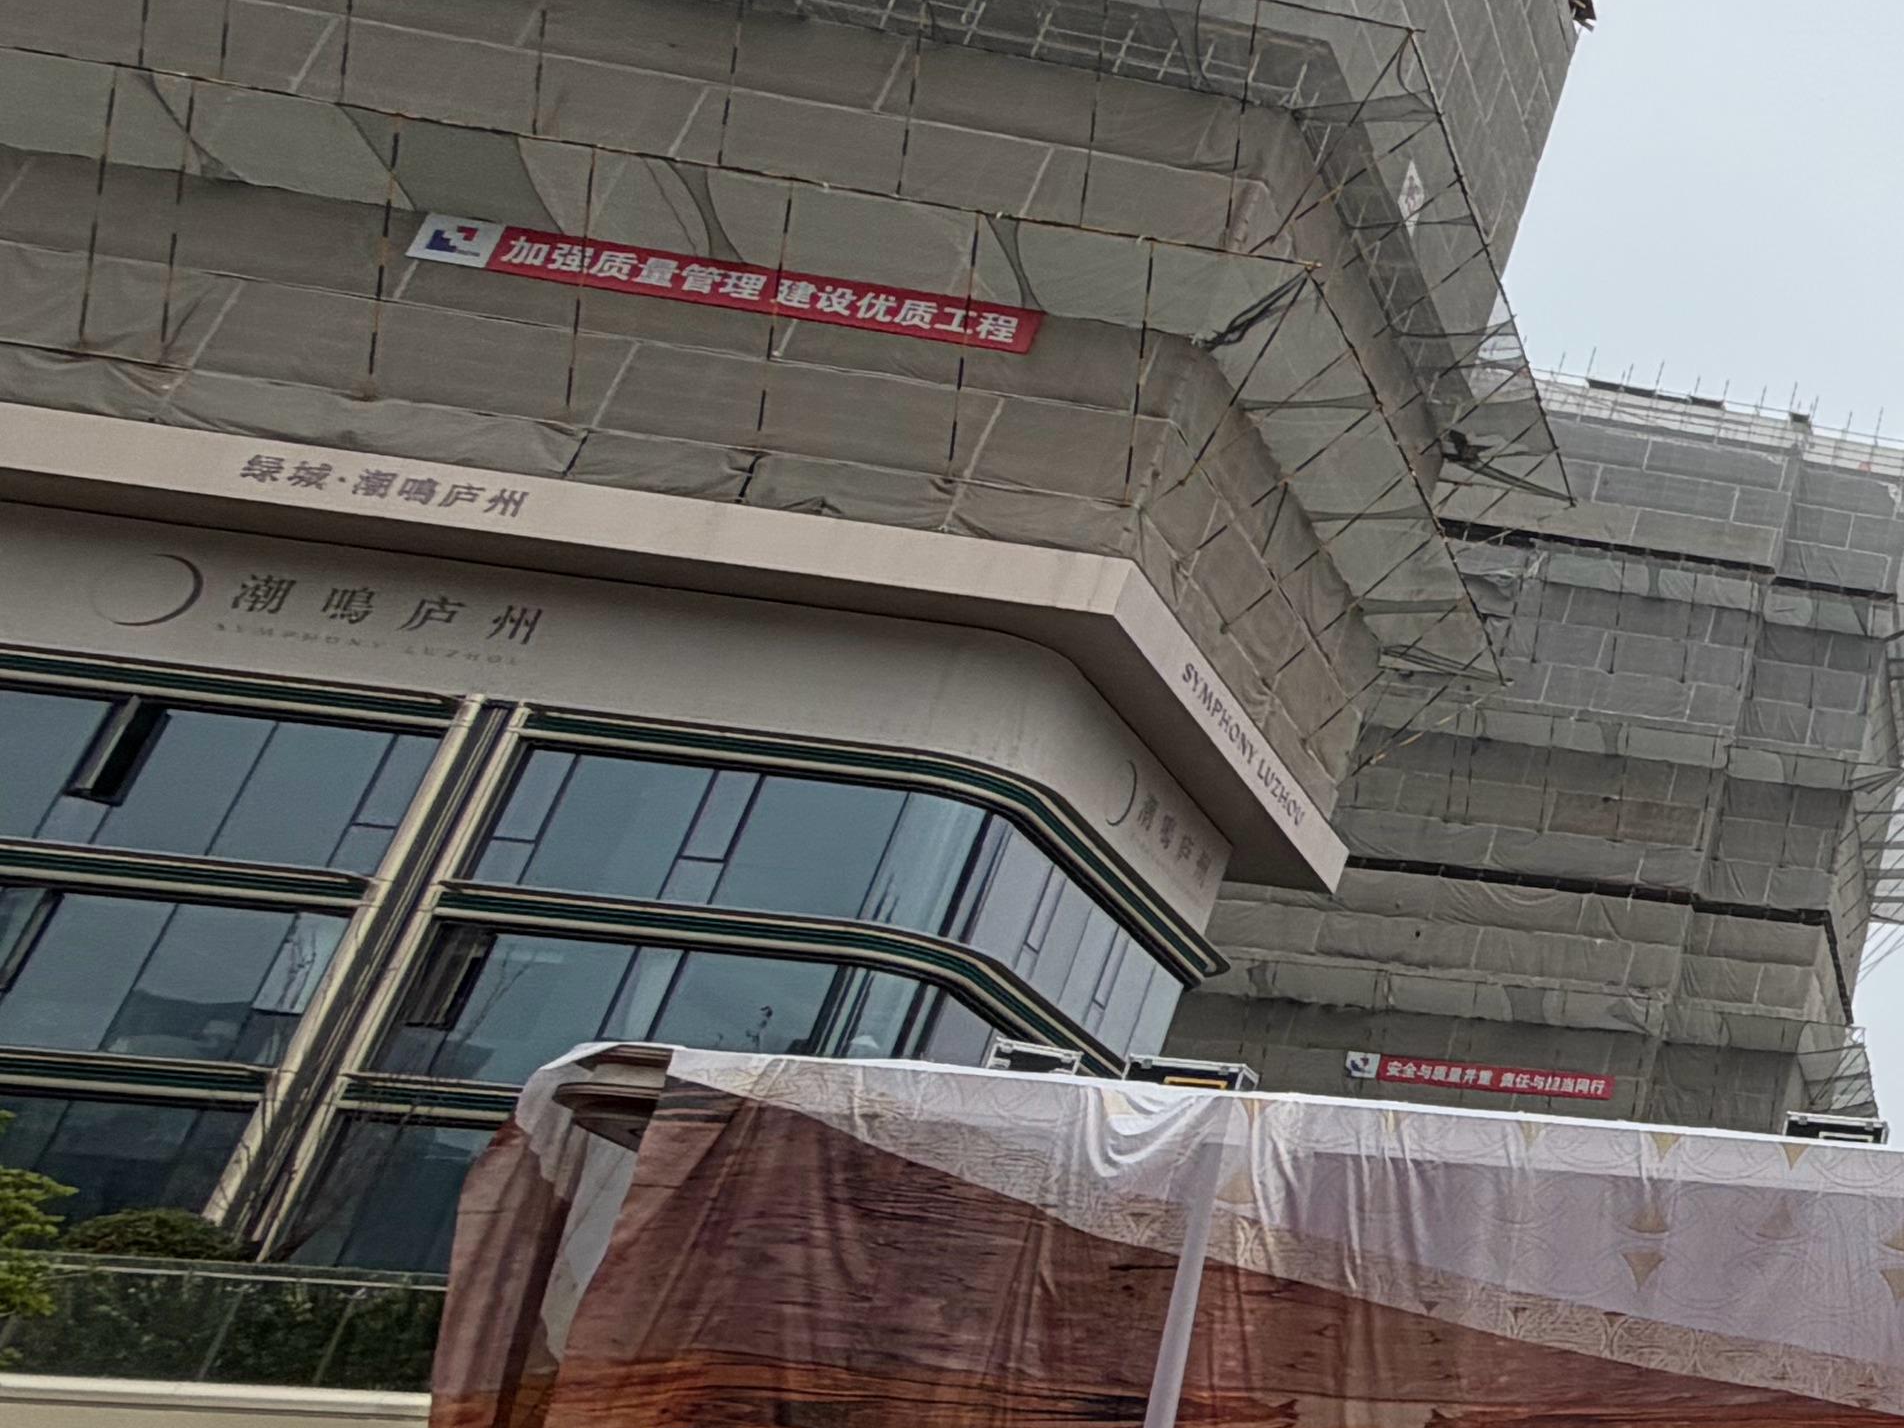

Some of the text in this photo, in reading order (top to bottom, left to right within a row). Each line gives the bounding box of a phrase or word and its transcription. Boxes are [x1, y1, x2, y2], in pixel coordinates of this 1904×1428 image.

[501, 234, 1020, 343] 加强质量管理 建设优质工程
[1182, 662, 1306, 827] SYMPHONY LUZHOU
